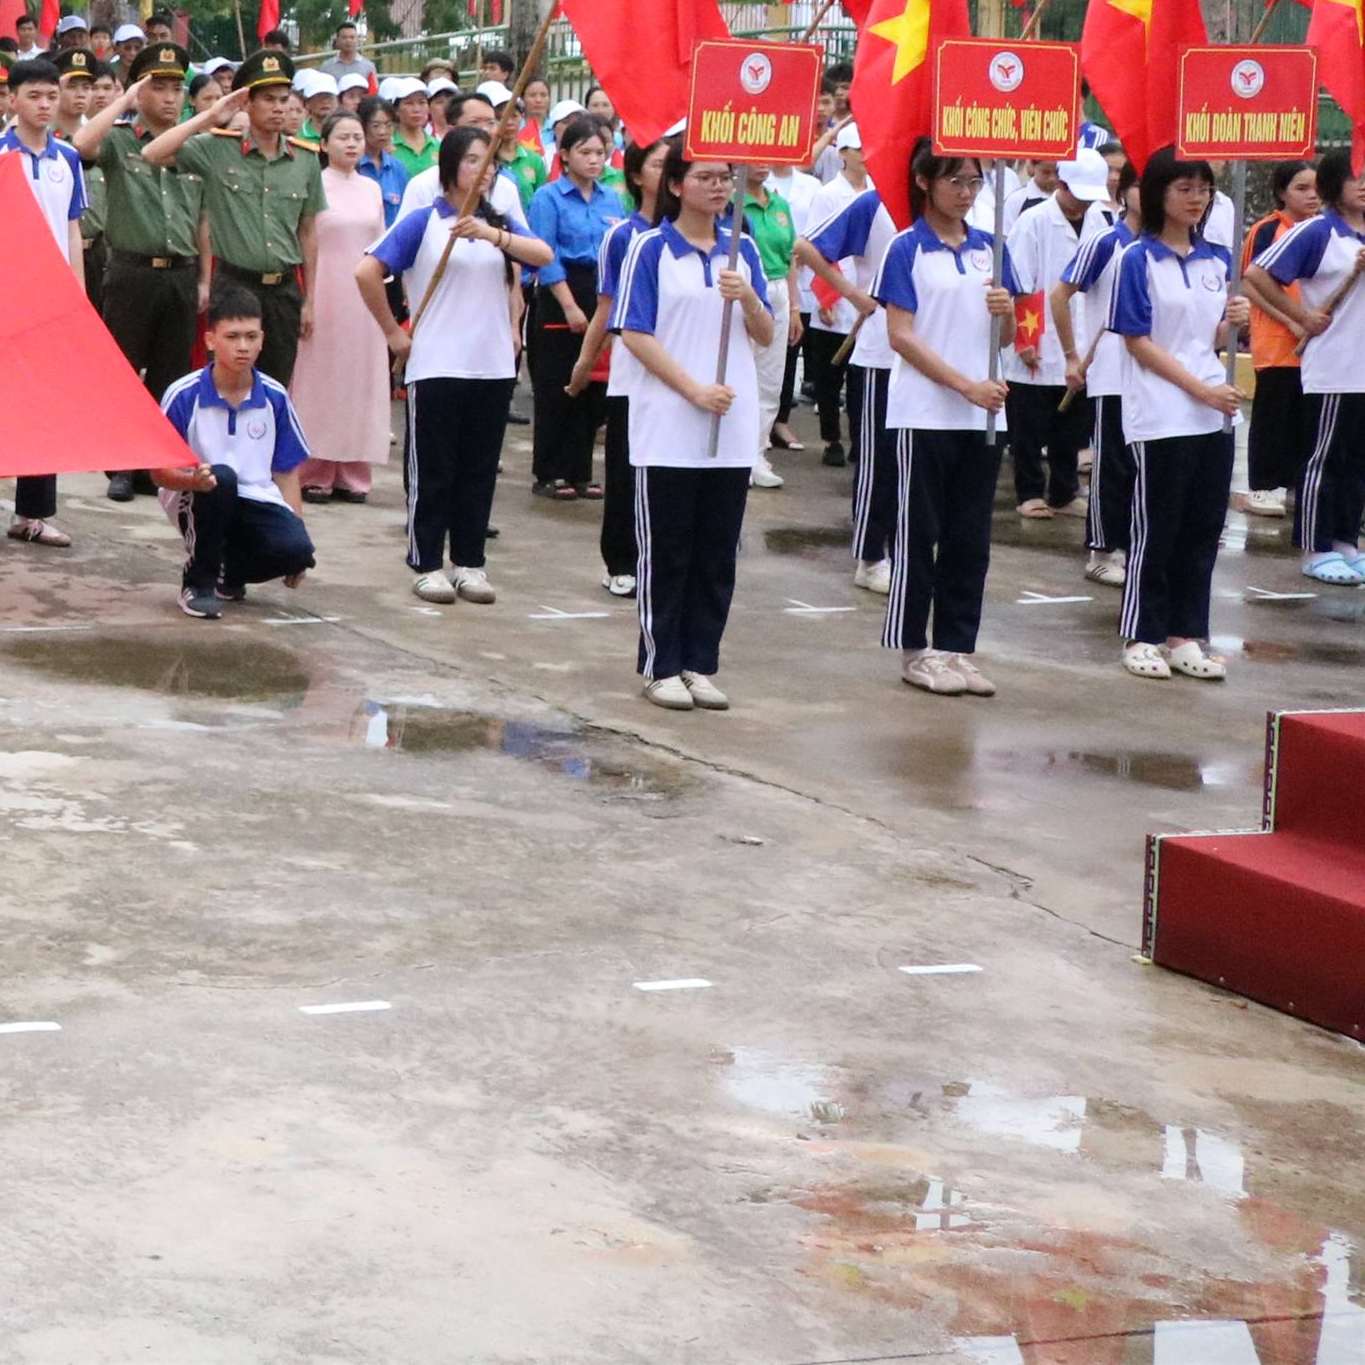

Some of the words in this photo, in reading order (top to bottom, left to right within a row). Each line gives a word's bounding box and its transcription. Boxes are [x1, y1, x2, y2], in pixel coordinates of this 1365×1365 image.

[700, 100, 735, 143] KHỐI
[737, 107, 776, 145] CÔNG
[778, 115, 800, 147] AN
[943, 95, 964, 138] KHỐI
[965, 101, 990, 138] CÔNG
[992, 102, 1018, 144] CHỨC,
[1021, 103, 1042, 140] VIÊN
[1043, 105, 1068, 142] CHỨC
[1186, 102, 1210, 142] KHỐI
[1243, 113, 1277, 142] THANH
[1279, 107, 1305, 142] NIÊN
